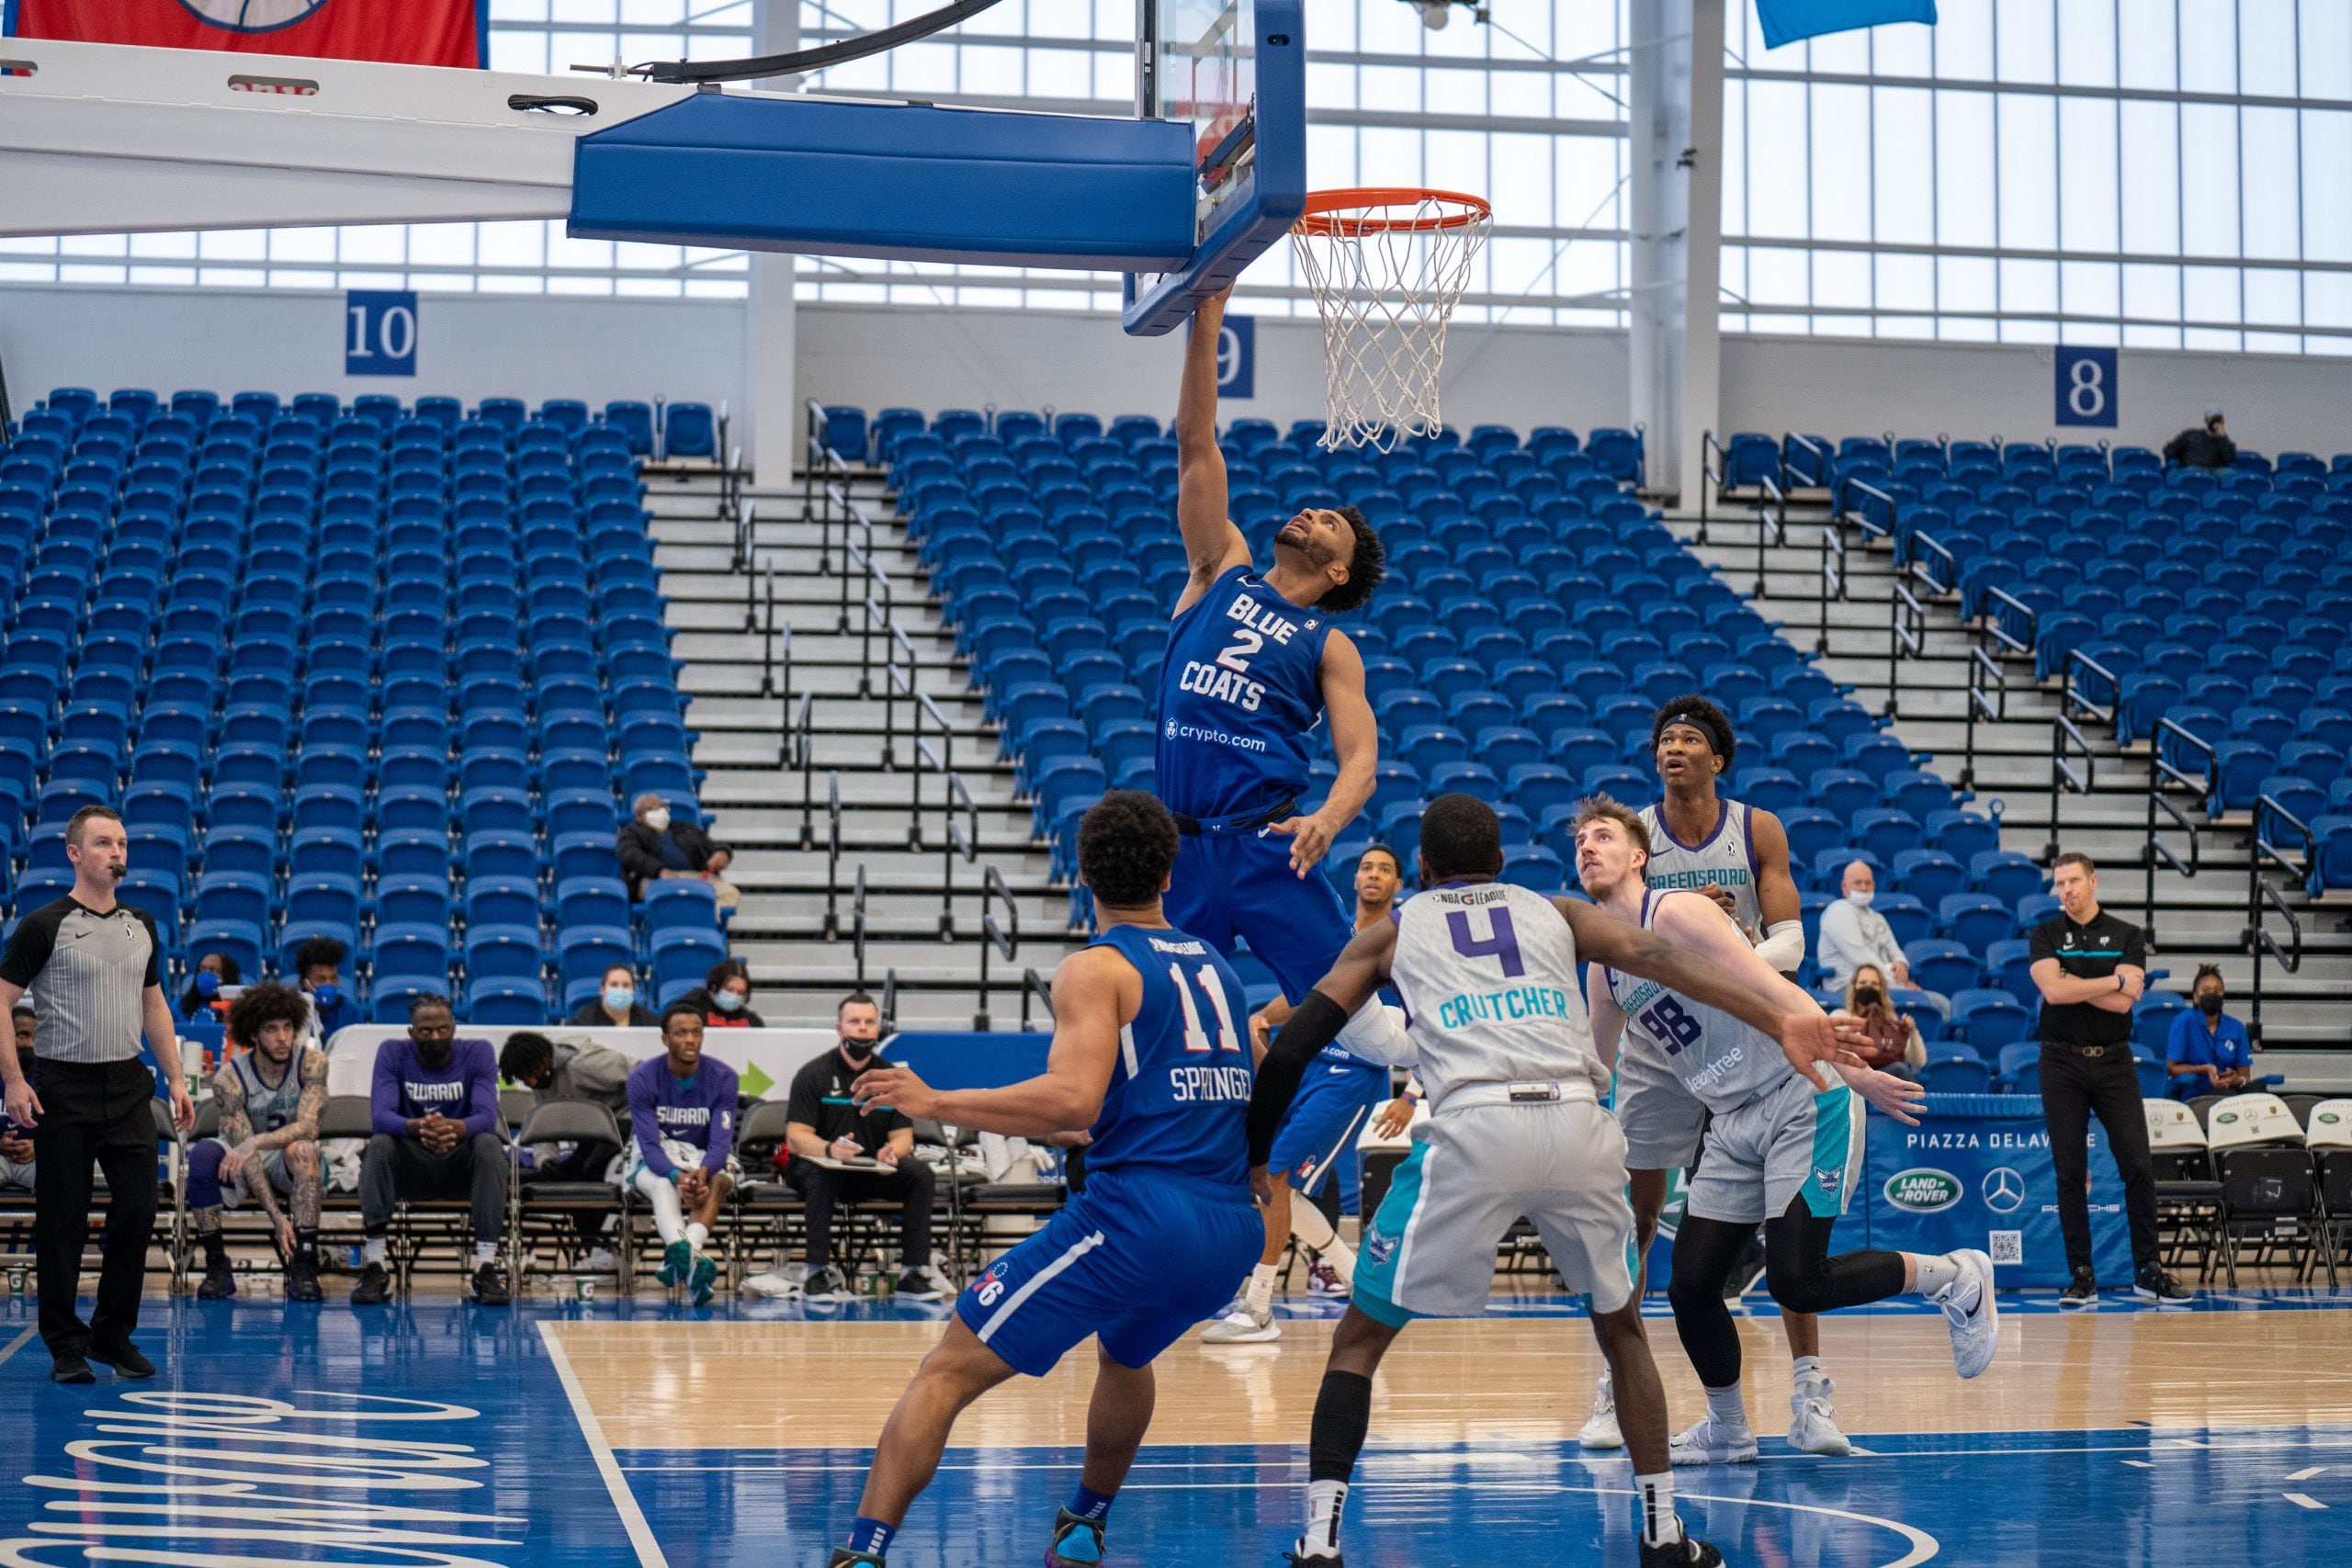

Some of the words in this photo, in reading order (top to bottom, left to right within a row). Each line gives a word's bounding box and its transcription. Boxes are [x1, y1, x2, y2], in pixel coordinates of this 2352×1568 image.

[348, 305, 416, 359] 10
[1217, 326, 1240, 386] 9
[2069, 358, 2104, 416] 8
[1227, 593, 1298, 646] BLUE
[1216, 628, 1263, 673] 2
[1180, 660, 1266, 711] COATS
[1181, 725, 1266, 752] crypto.com
[1646, 868, 1747, 889] GREENSBORO
[1441, 893, 1461, 904] NBA
[1445, 906, 1526, 977] 4
[1169, 963, 1240, 1054] 11
[1439, 986, 1570, 1029] CRUTCHER
[1639, 994, 1702, 1056] 98
[404, 1080, 464, 1101] SWARM
[1170, 1066, 1251, 1101] SPRINGE
[656, 1106, 710, 1126] SWARM
[1906, 1133, 1980, 1148] PIAZZA
[1989, 1133, 2096, 1147] DELAE
[1900, 1178, 1938, 1190] LAND
[1904, 1190, 1949, 1201] ROVER
[2041, 1203, 2120, 1213] POCHE
